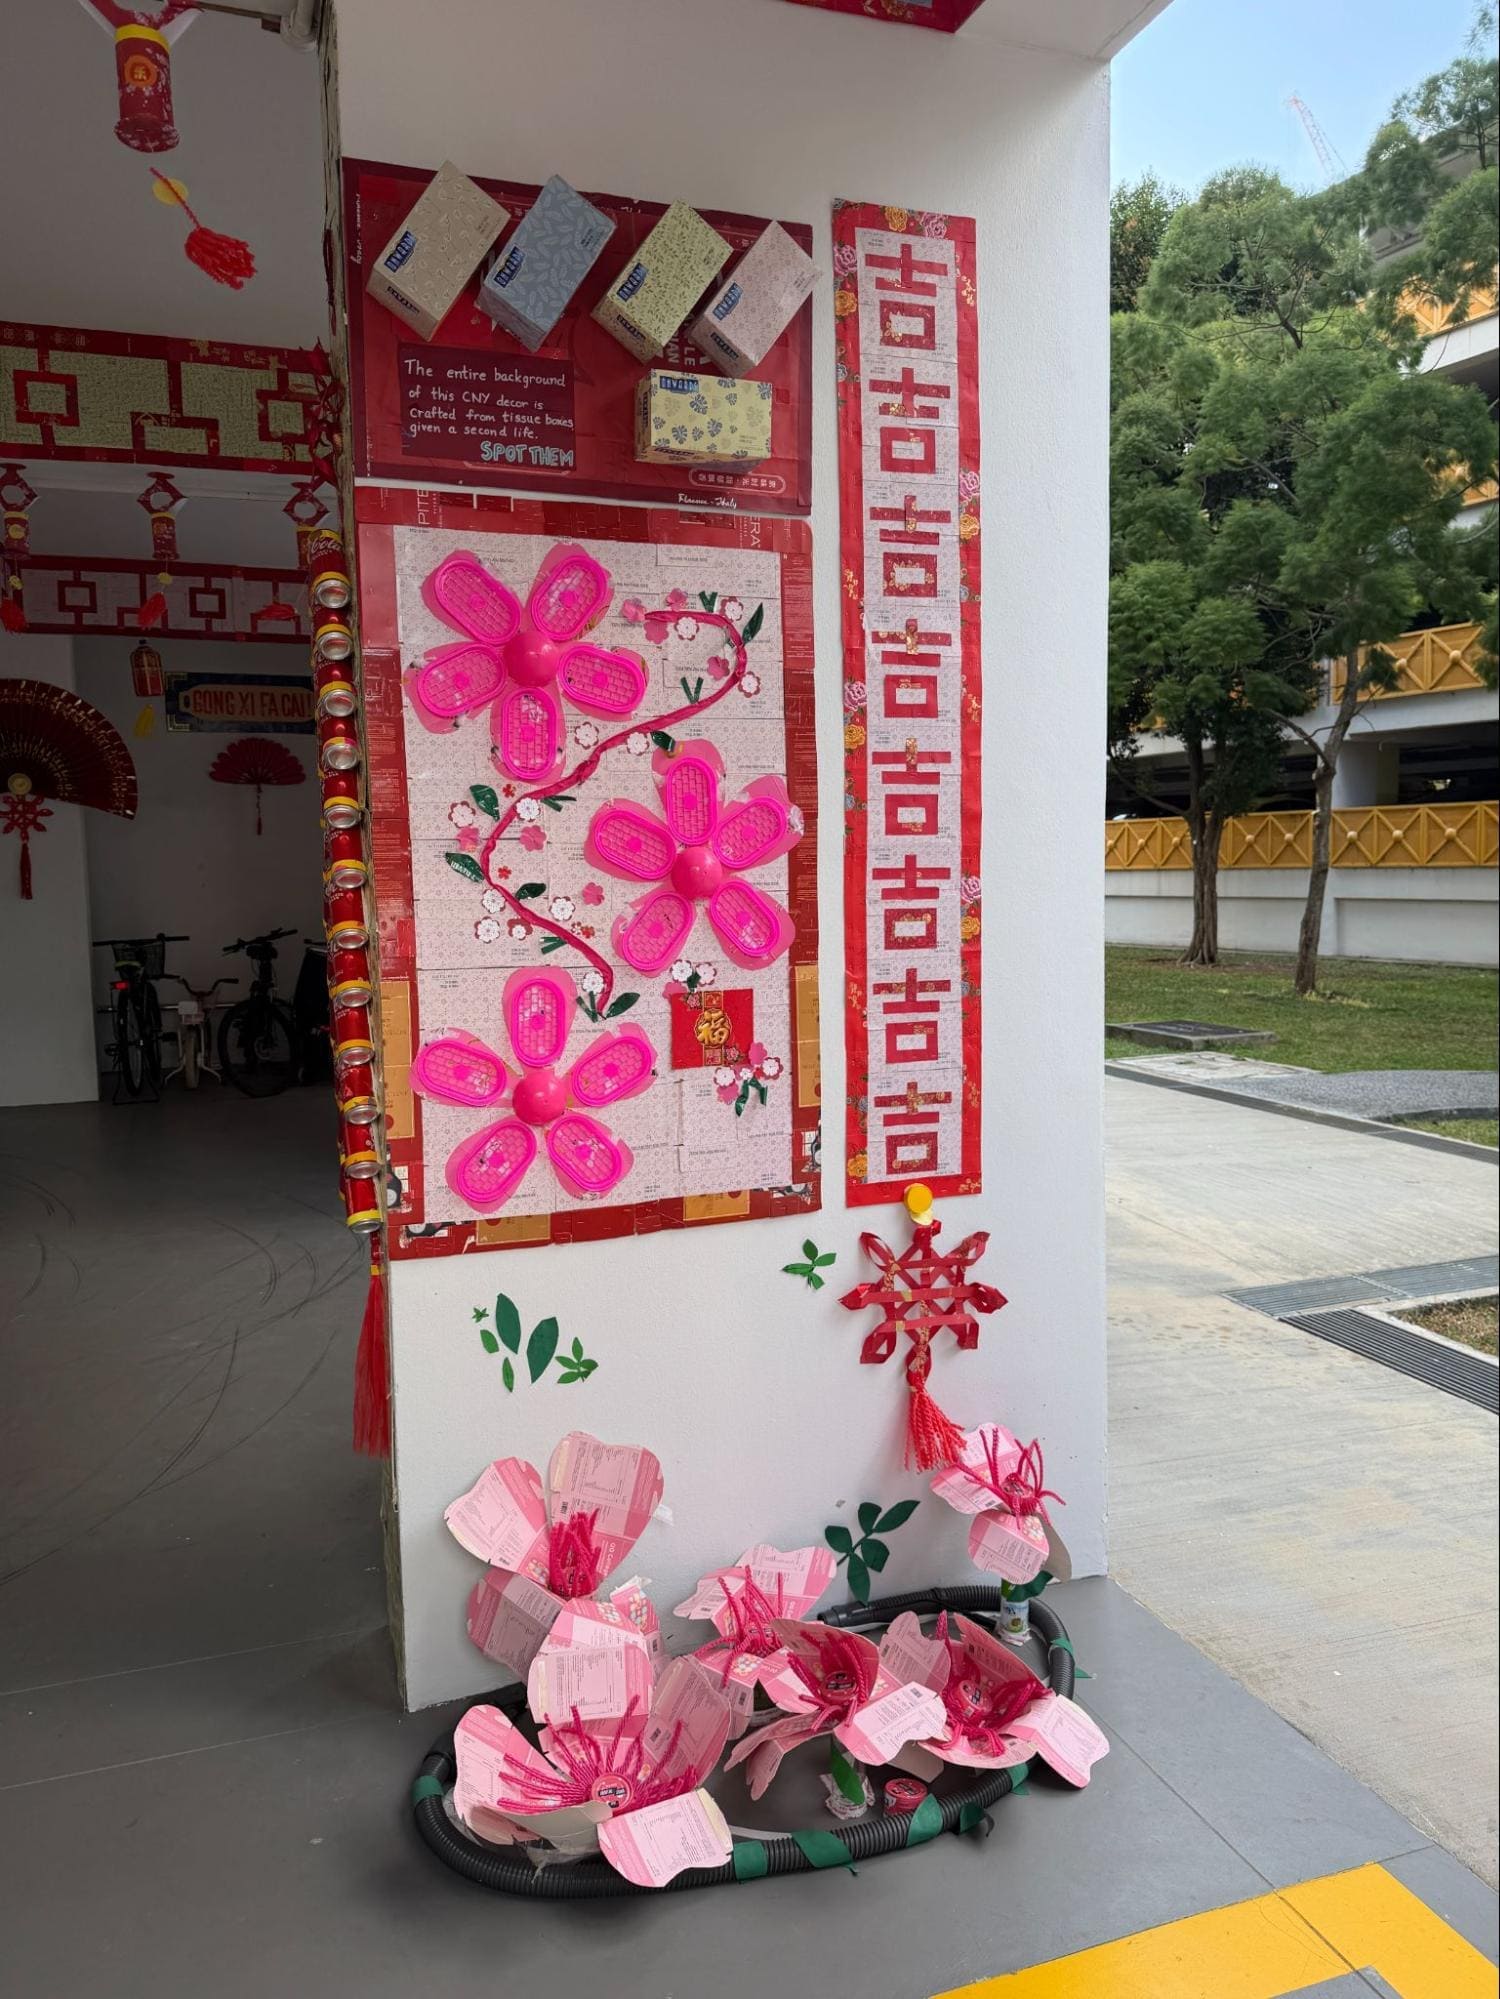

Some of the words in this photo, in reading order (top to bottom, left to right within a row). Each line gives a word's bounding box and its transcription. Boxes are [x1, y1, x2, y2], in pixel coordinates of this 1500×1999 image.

[404, 359, 433, 377] The
[446, 366, 487, 382] entire
[494, 367, 566, 389] background
[408, 385, 422, 398] of
[430, 386, 455, 402] this
[462, 391, 490, 404] CNY
[496, 395, 529, 408] decor
[534, 400, 544, 410] is
[409, 422, 441, 438] given
[448, 426, 457, 434] a
[463, 425, 507, 437] second
[513, 426, 539, 439] life.
[465, 409, 495, 423] from
[502, 411, 541, 425] tissue
[480, 440, 527, 463] SPOT
[529, 445, 574, 467] THEM
[192, 690, 236, 715] GONG
[238, 691, 255, 716] XI
[260, 692, 278, 717] FA
[697, 1010, 730, 1045] 福
